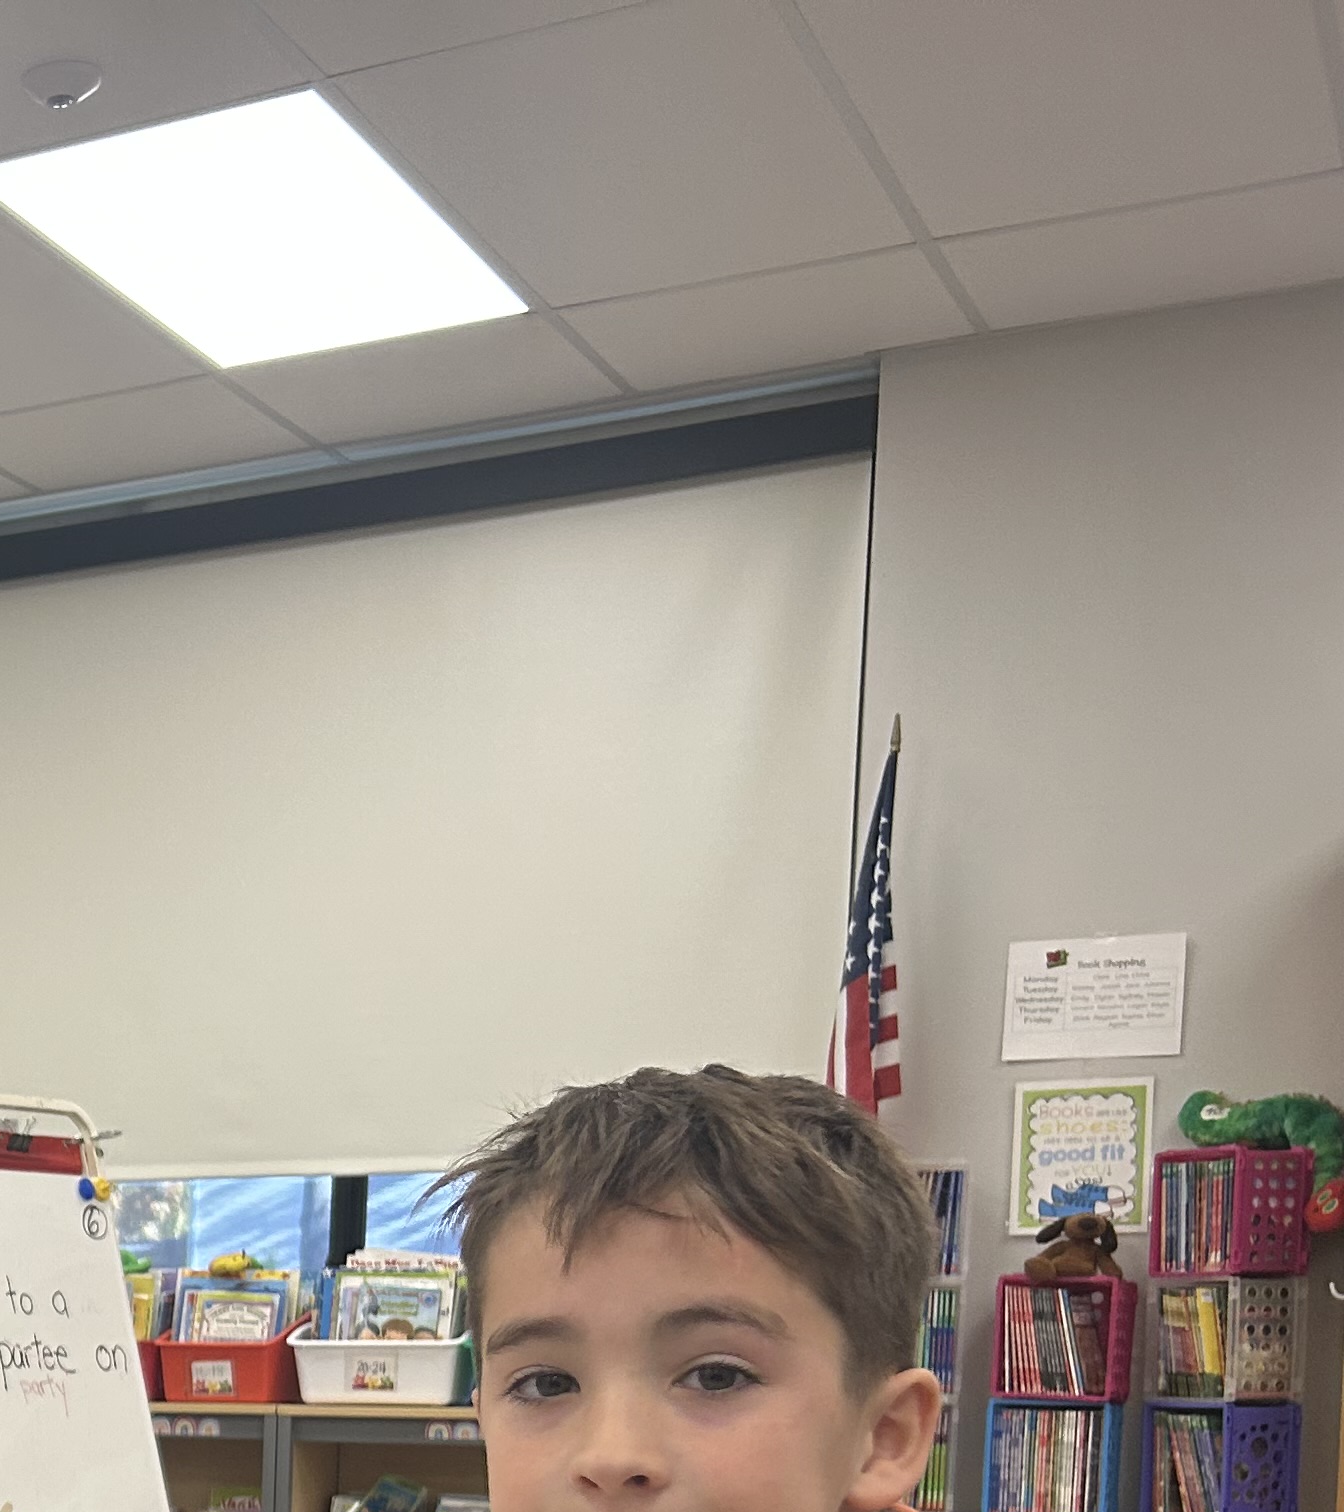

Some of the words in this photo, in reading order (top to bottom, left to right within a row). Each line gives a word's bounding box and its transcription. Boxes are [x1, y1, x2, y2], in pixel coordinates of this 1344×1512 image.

[1039, 1144, 1095, 1166] good
[1101, 1144, 1125, 1161] fit
[87, 1210, 102, 1236] 6
[6, 1274, 33, 1316] to
[52, 1290, 70, 1319] a
[96, 1344, 128, 1374] on
[20, 1374, 69, 1418] party
